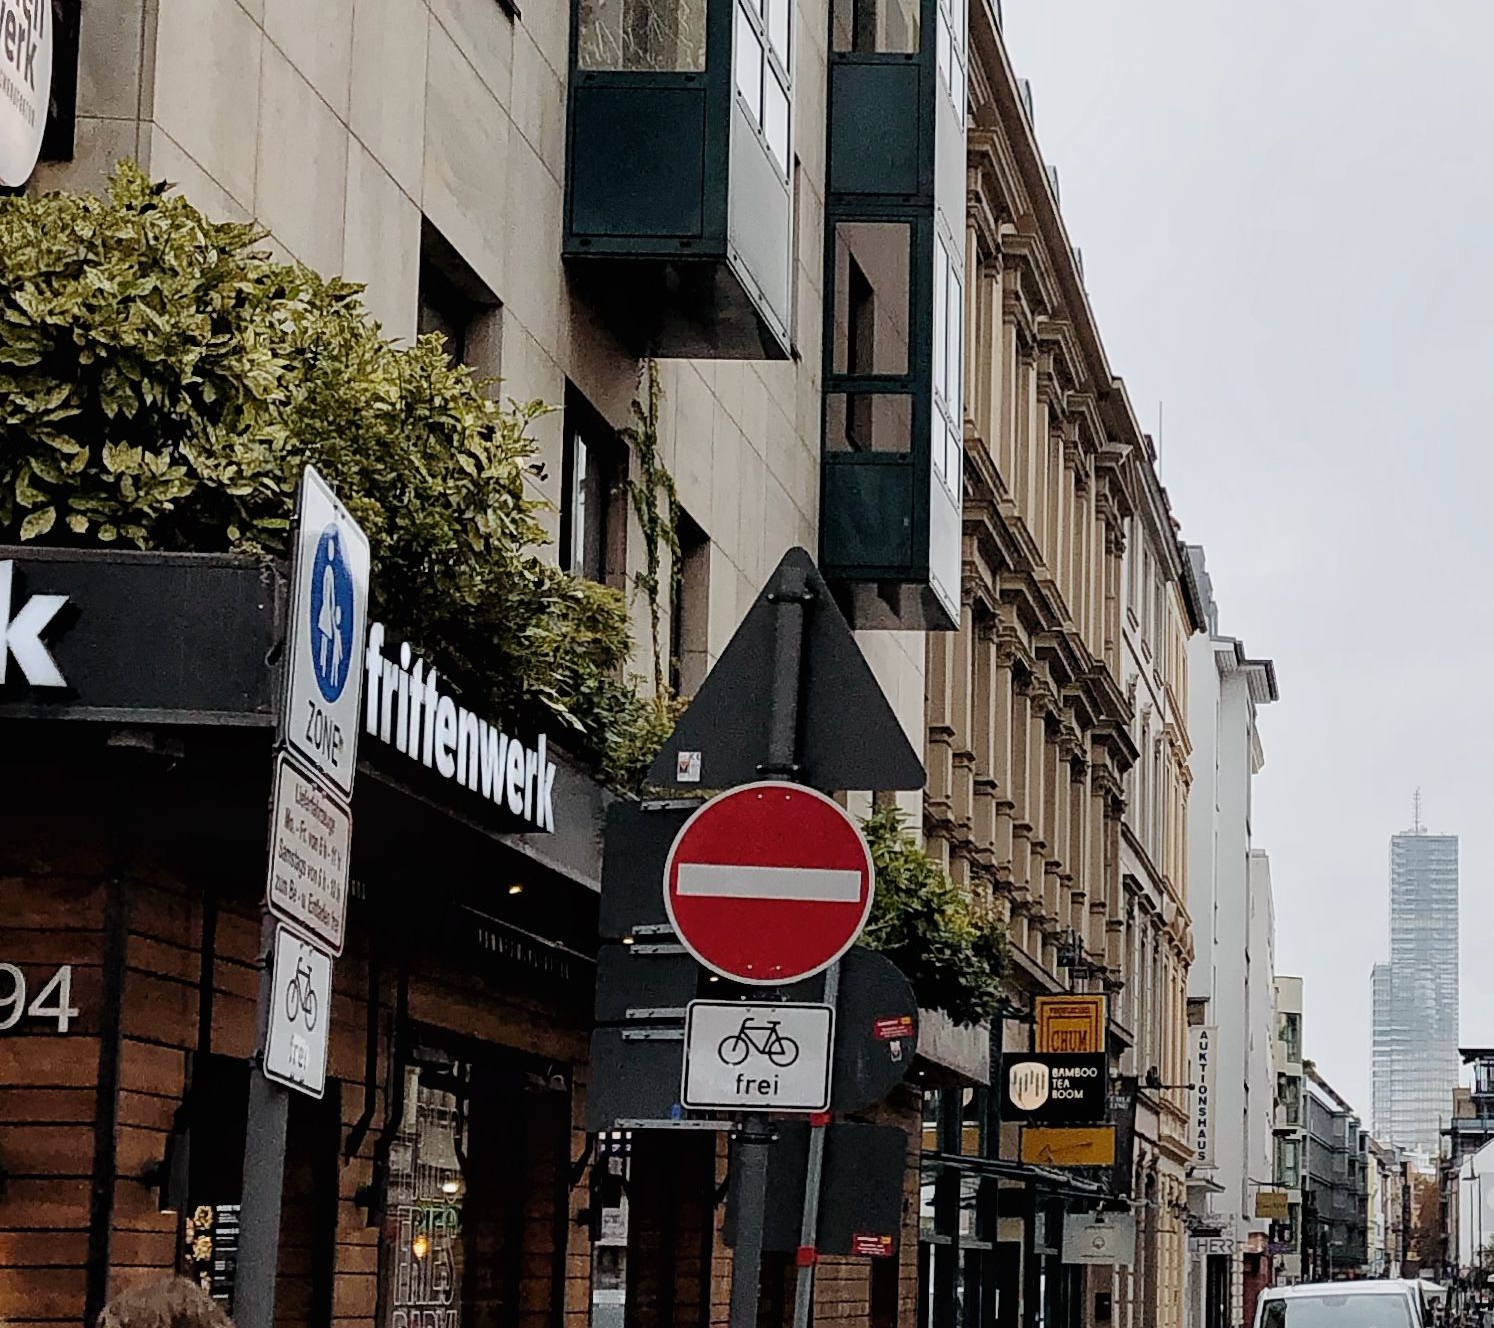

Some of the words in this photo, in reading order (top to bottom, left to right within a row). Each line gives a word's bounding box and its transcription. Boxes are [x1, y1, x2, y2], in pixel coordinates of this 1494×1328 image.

[306, 699, 344, 767] ZONE
[366, 622, 556, 834] frittenwerk
[735, 1073, 780, 1096] frei
[1051, 1067, 1098, 1078] BAMBOO
[1051, 1078, 1071, 1088] TEA
[1197, 1030, 1209, 1161] AUKTIONSHAUS
